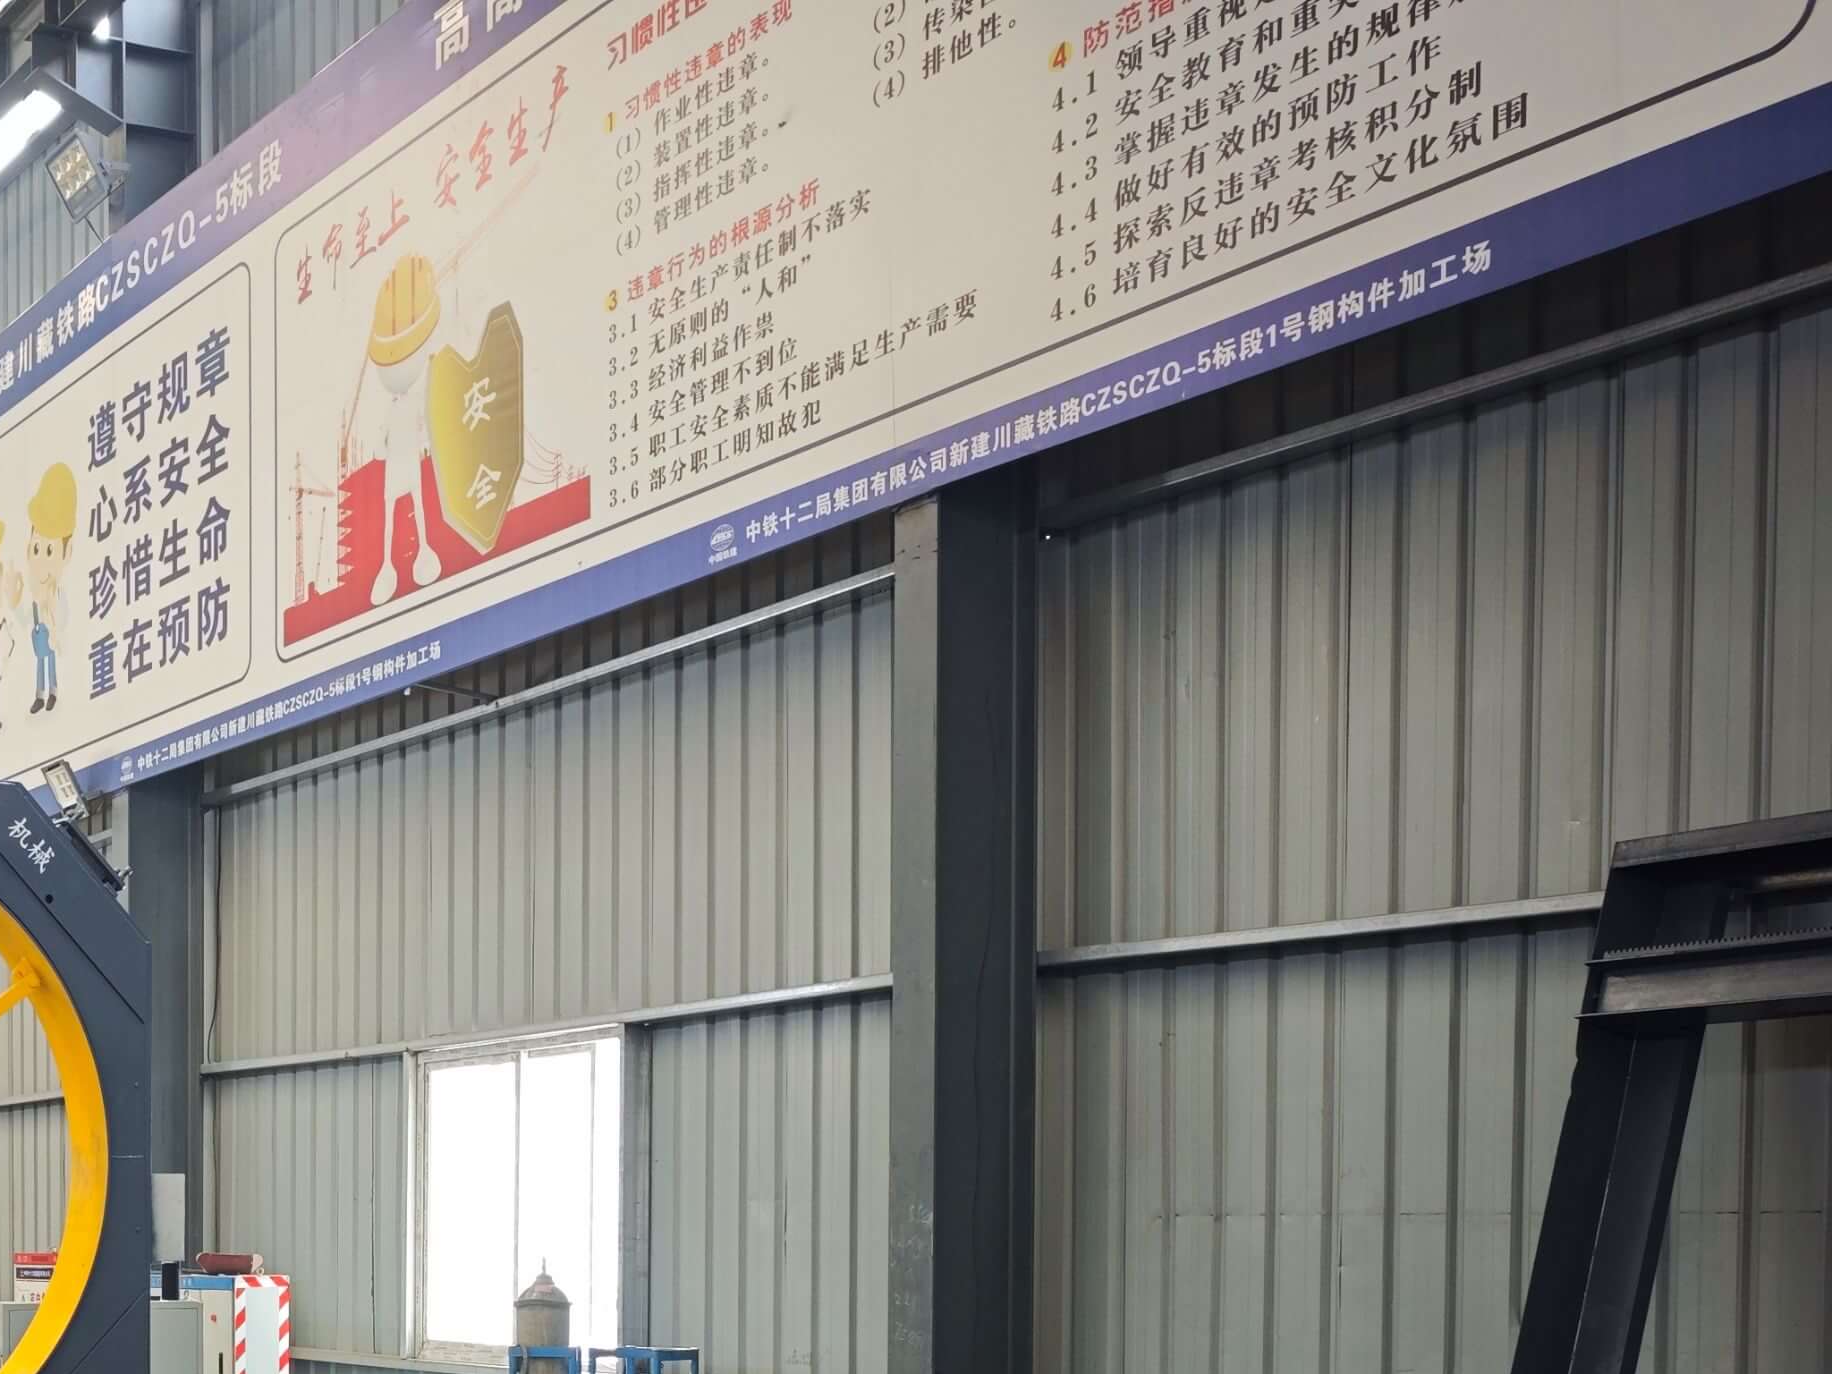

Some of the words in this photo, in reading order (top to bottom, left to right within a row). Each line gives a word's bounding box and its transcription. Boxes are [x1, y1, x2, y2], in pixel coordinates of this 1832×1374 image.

[615, 129, 642, 158] (1)
[653, 52, 769, 137] 作业性违章。
[624, 0, 792, 120] 习惯性违章的表现
[871, 70, 906, 108] (4)
[922, 12, 1016, 80] 排他性。
[872, 33, 906, 71] (3)
[1051, 70, 1097, 111] 4.1
[1052, 41, 1066, 68] 4
[295, 190, 410, 304] 生命至上
[433, 65, 569, 208] 安全生产
[615, 161, 641, 192] (2)
[653, 87, 769, 169] 装置性违章。
[615, 193, 641, 224] (3)
[653, 121, 769, 202] 指挥性违章。
[1050, 197, 1097, 239] 4.4
[1114, 36, 1442, 212] 做好有效的预防工作
[1050, 241, 1097, 281] 4.5
[1112, 61, 1482, 255] 探索反违章考核积分制
[1051, 112, 1098, 154] 4.2
[1051, 155, 1098, 197] 4.3
[615, 226, 641, 257] (4)
[653, 157, 769, 235] 管理性违章。
[626, 178, 820, 302] 违章行为的根源分析
[1050, 284, 1097, 322] 4.6
[1112, 92, 1528, 296] 培育良好的安全文化氛围
[608, 314, 637, 344] 3.1
[648, 188, 871, 325] 安全生产责任制不落实
[608, 347, 638, 377] 3.2
[647, 298, 729, 359] 无原则的
[608, 380, 638, 410] 3.3
[647, 311, 775, 393] 经济利益作祟
[608, 448, 638, 476] 3.5
[647, 289, 978, 458] 职工安全素质不能满足生产需要
[608, 413, 638, 443] 3.4
[647, 336, 799, 426] 安全管理不到位
[87, 325, 231, 473] 遵守规章
[462, 377, 502, 511] 安全
[745, 239, 1492, 545] 中铁十二局集团有限公司新建川藏铁路CZSCZQ-5标段1号钢构件加工场
[88, 413, 231, 543] 心系安全
[608, 480, 638, 508] 3.6
[647, 401, 823, 494] 部分职工明知故犯
[88, 496, 231, 620] 珍惜生命
[88, 576, 231, 701] 重在预防
[7, 817, 56, 875] 机械
